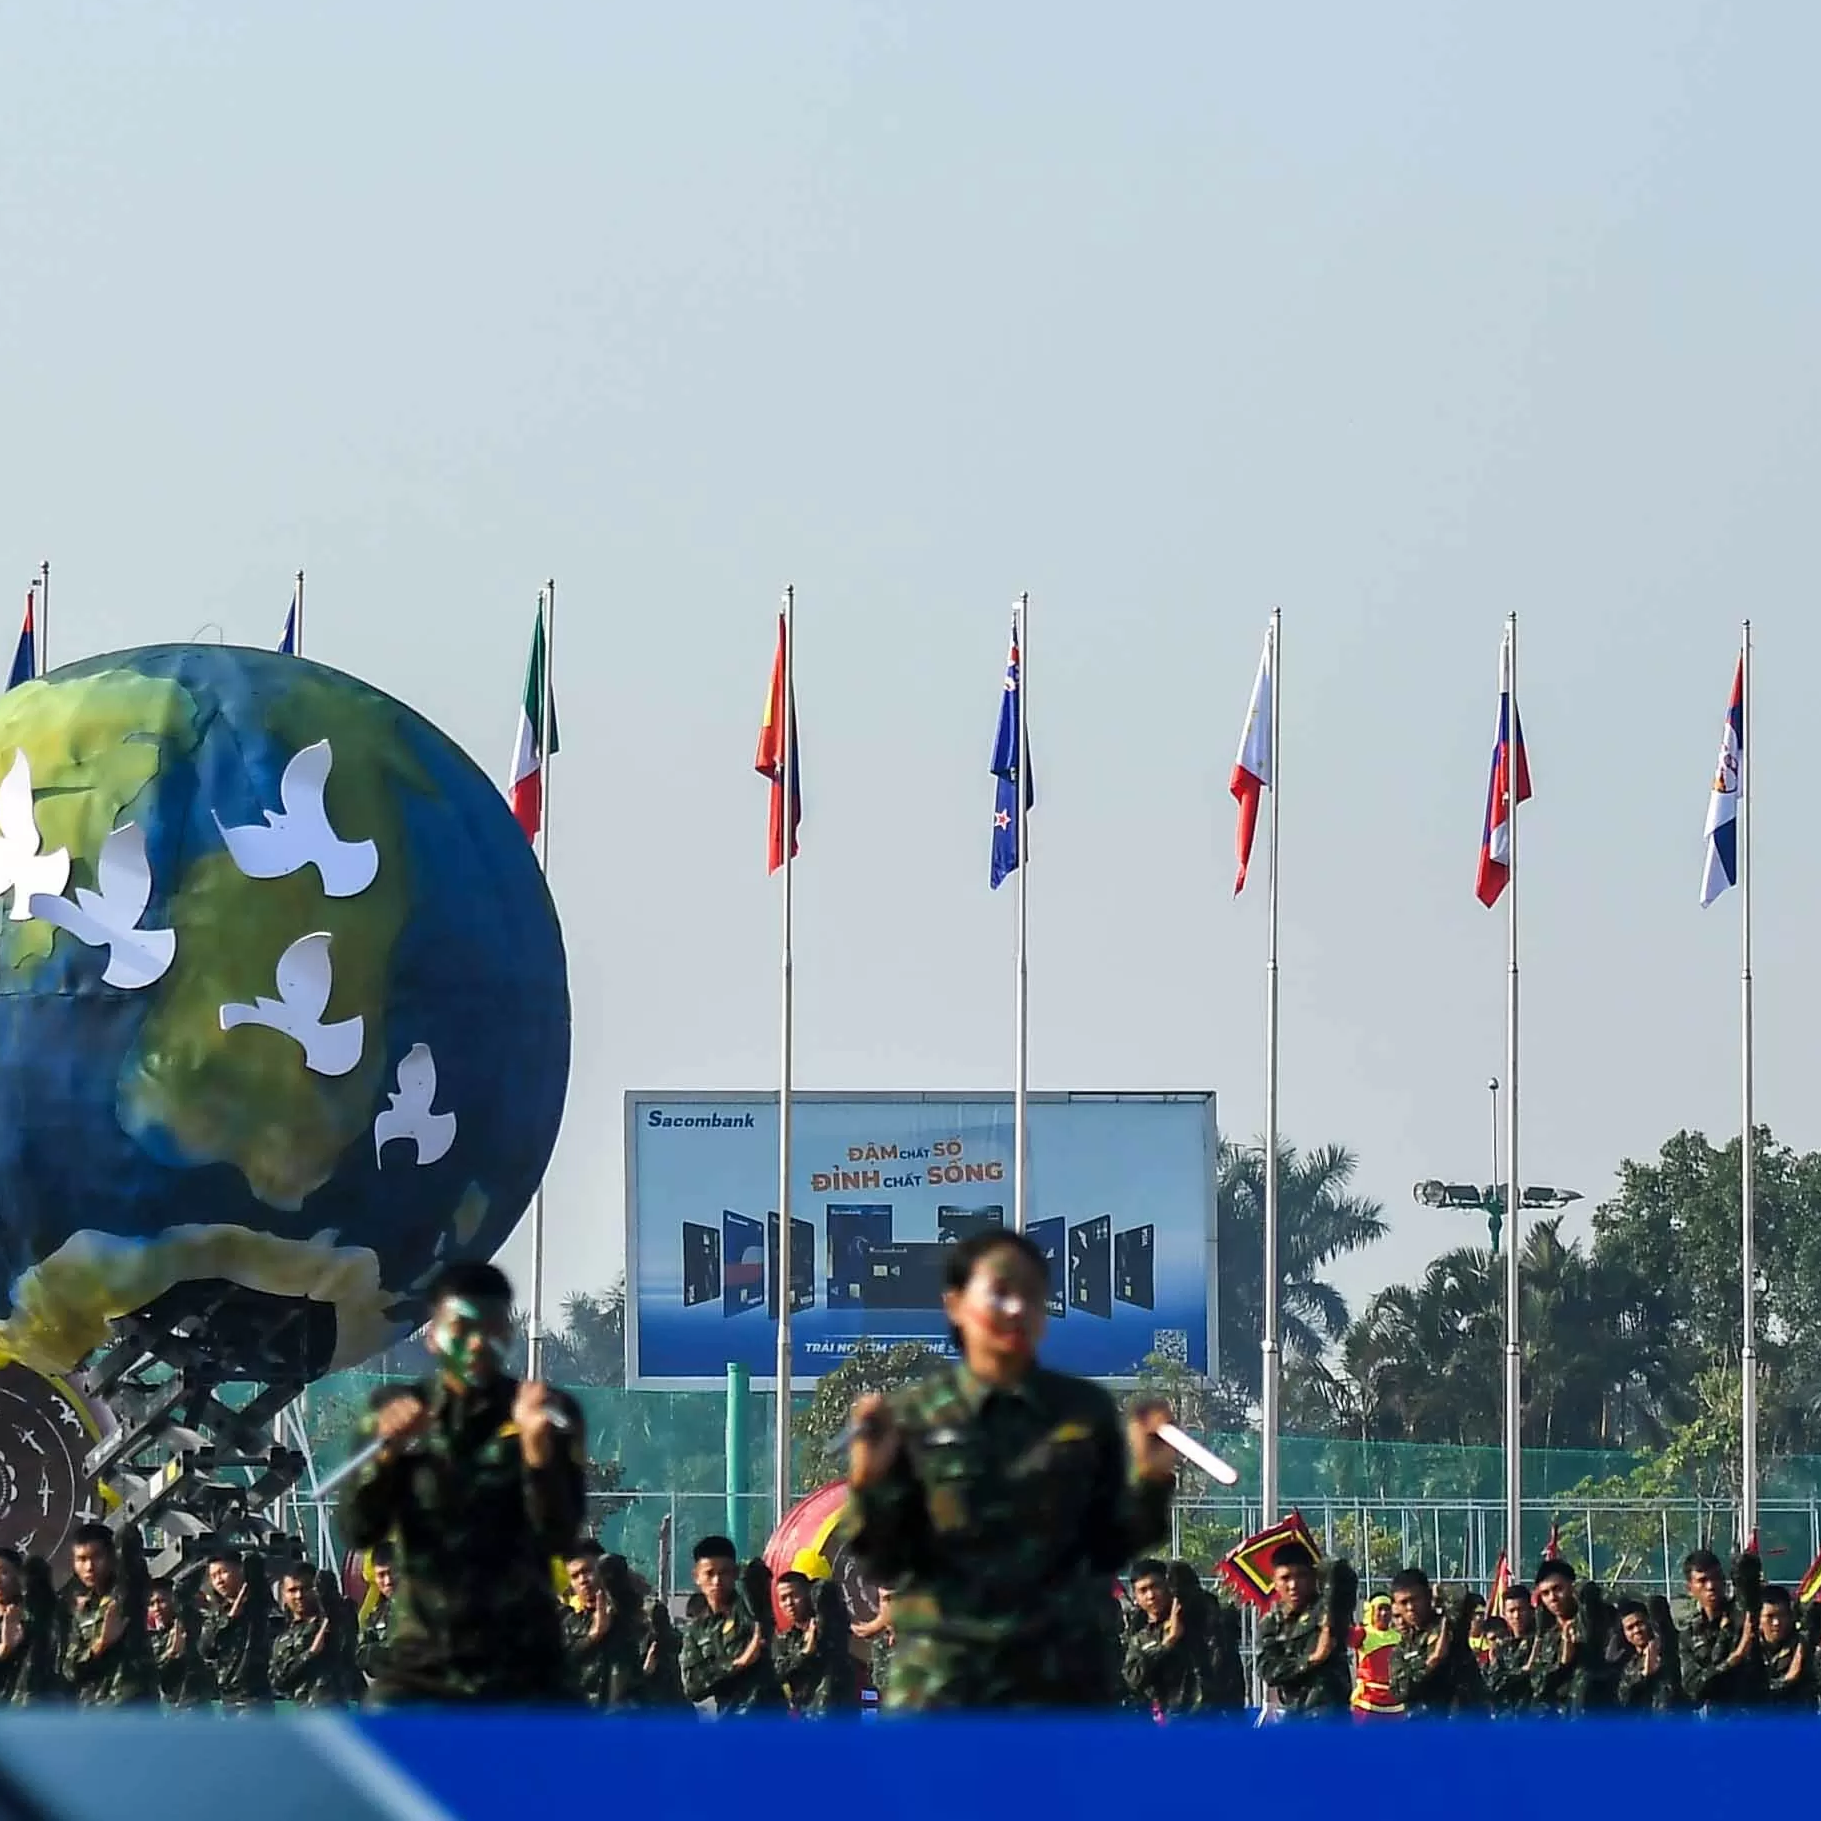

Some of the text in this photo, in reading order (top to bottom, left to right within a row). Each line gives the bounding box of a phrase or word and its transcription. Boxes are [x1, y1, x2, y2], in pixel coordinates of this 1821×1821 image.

[647, 1109, 755, 1128] Sacombank
[847, 1134, 963, 1165] ĐẬM CHẤT SỐ
[811, 1156, 1004, 1192] ĐỈNH CHẤT SỐNG
